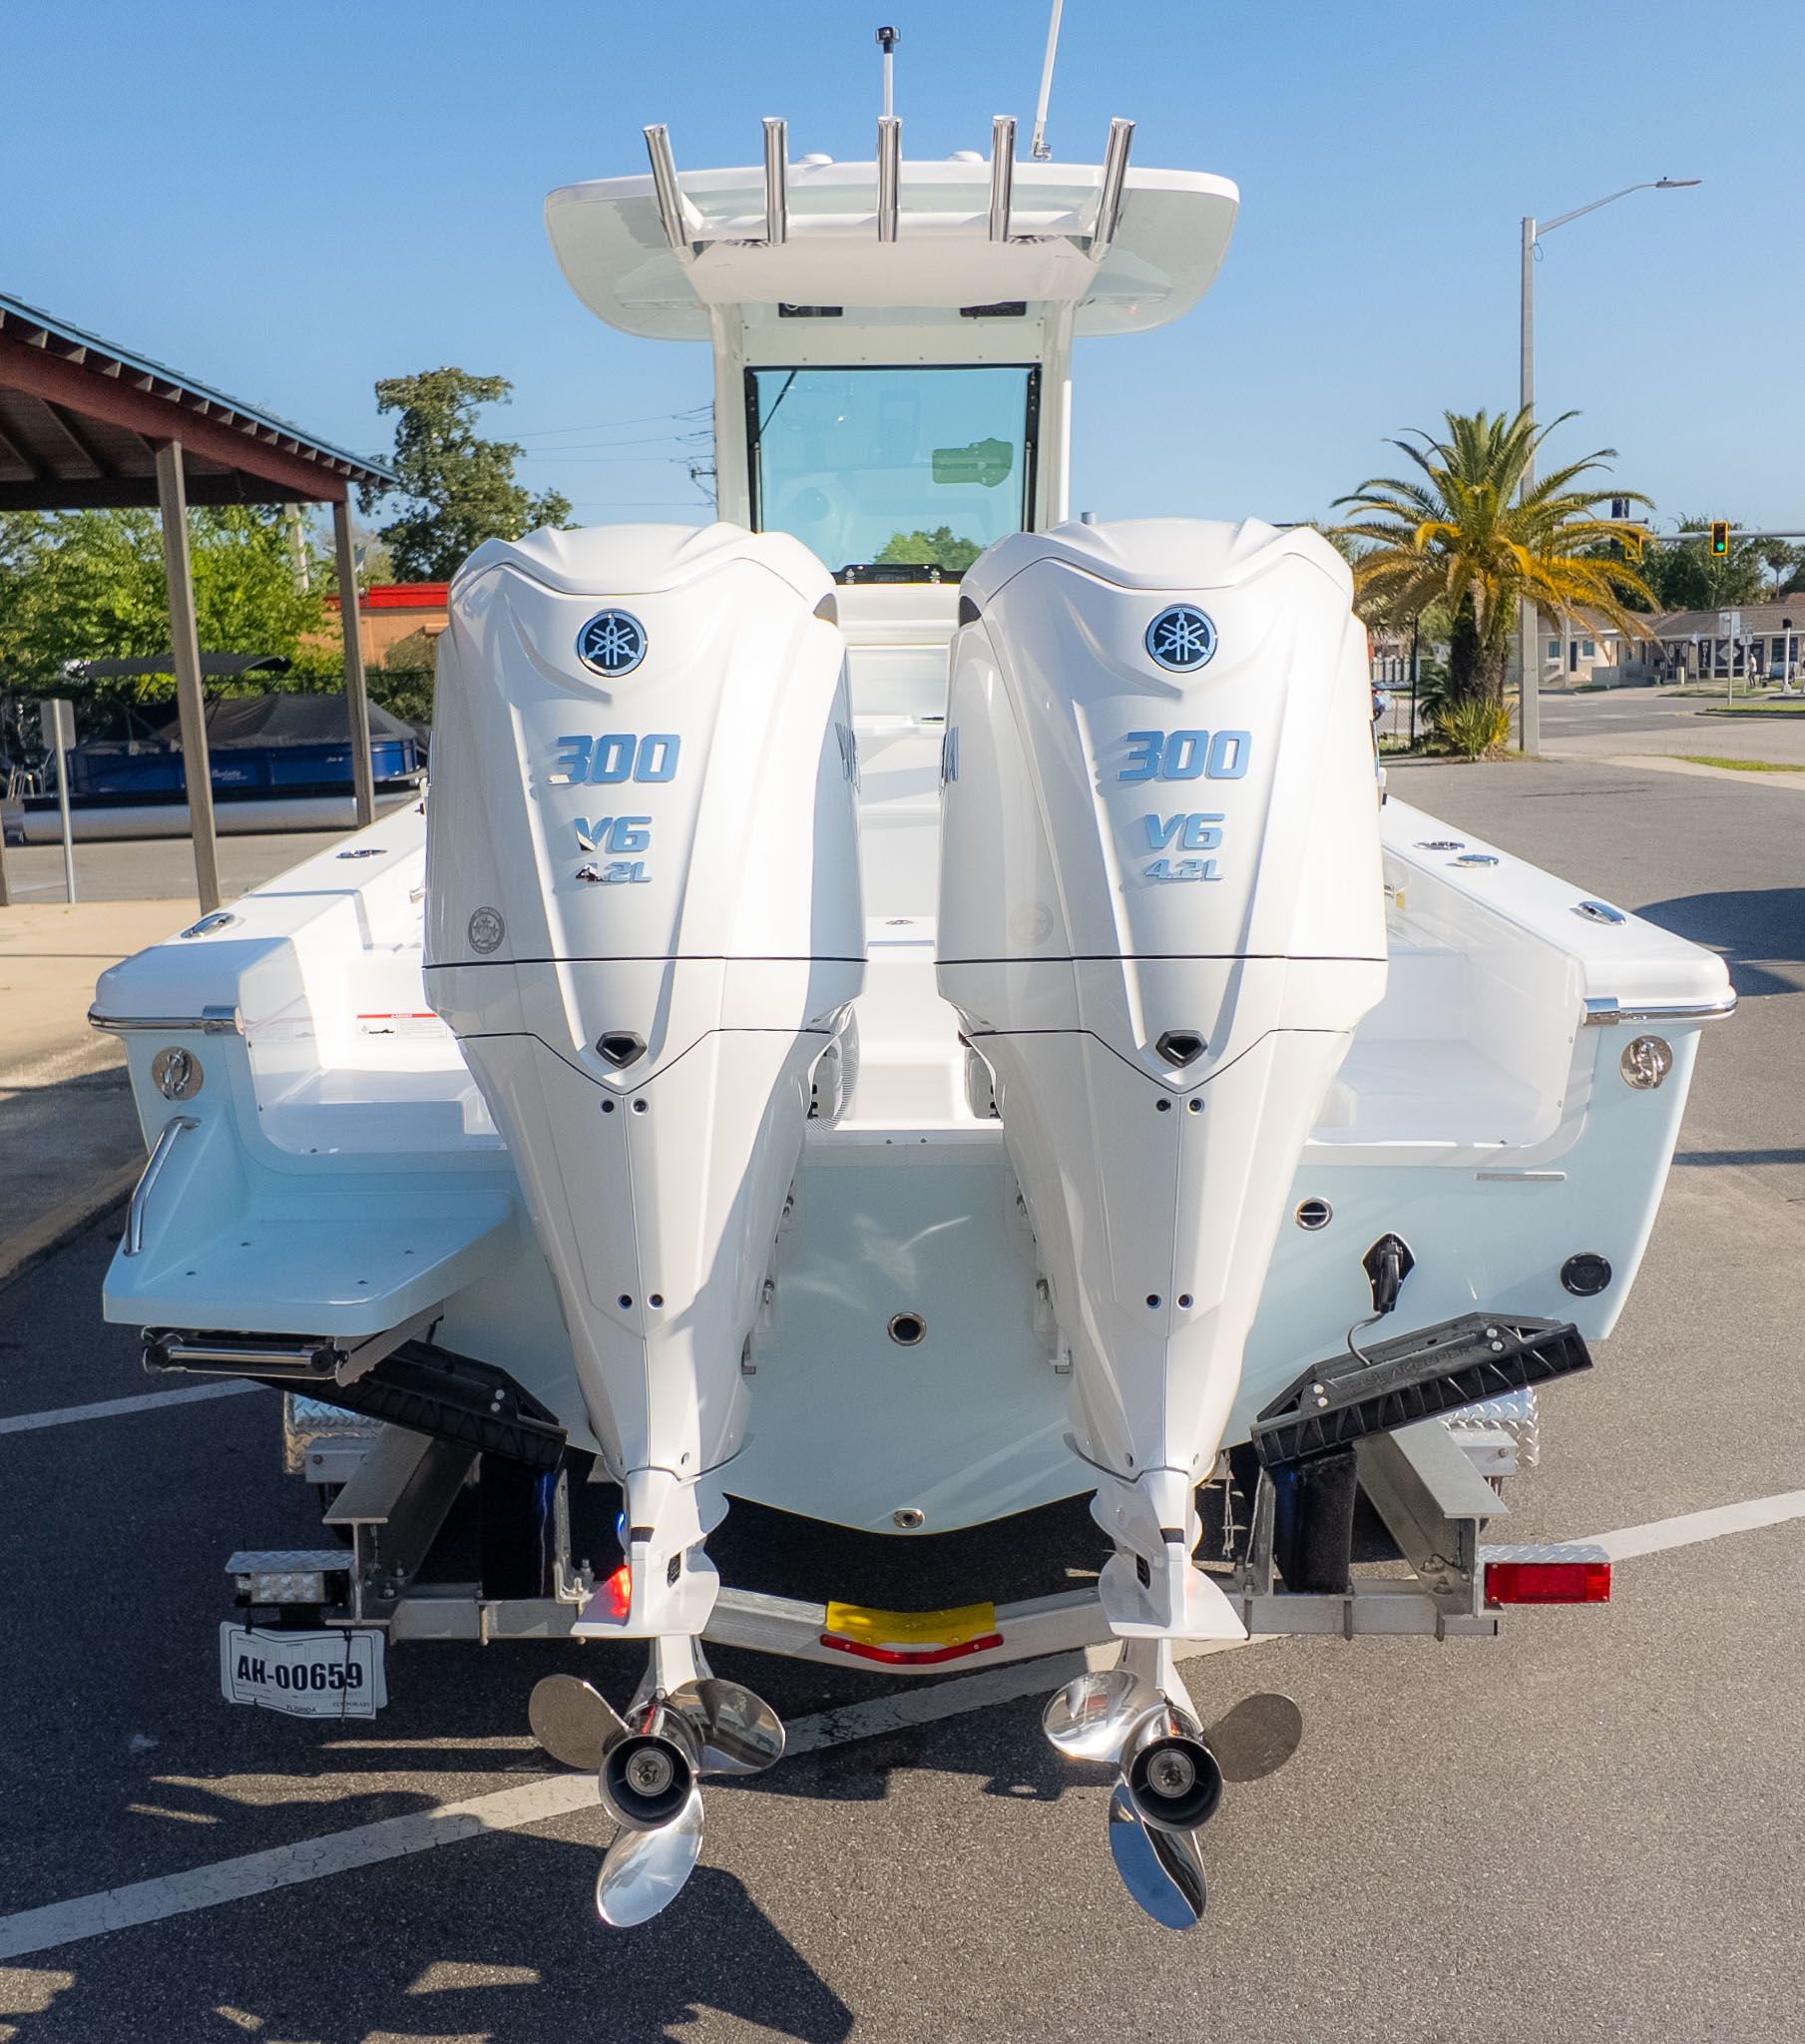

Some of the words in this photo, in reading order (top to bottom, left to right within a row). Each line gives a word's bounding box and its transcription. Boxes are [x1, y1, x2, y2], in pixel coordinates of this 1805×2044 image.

[549, 734, 681, 785] 300
[1118, 730, 1252, 781] 300
[574, 815, 653, 852] V6
[1144, 812, 1226, 849] V6
[237, 1654, 363, 1692] AH-00659
